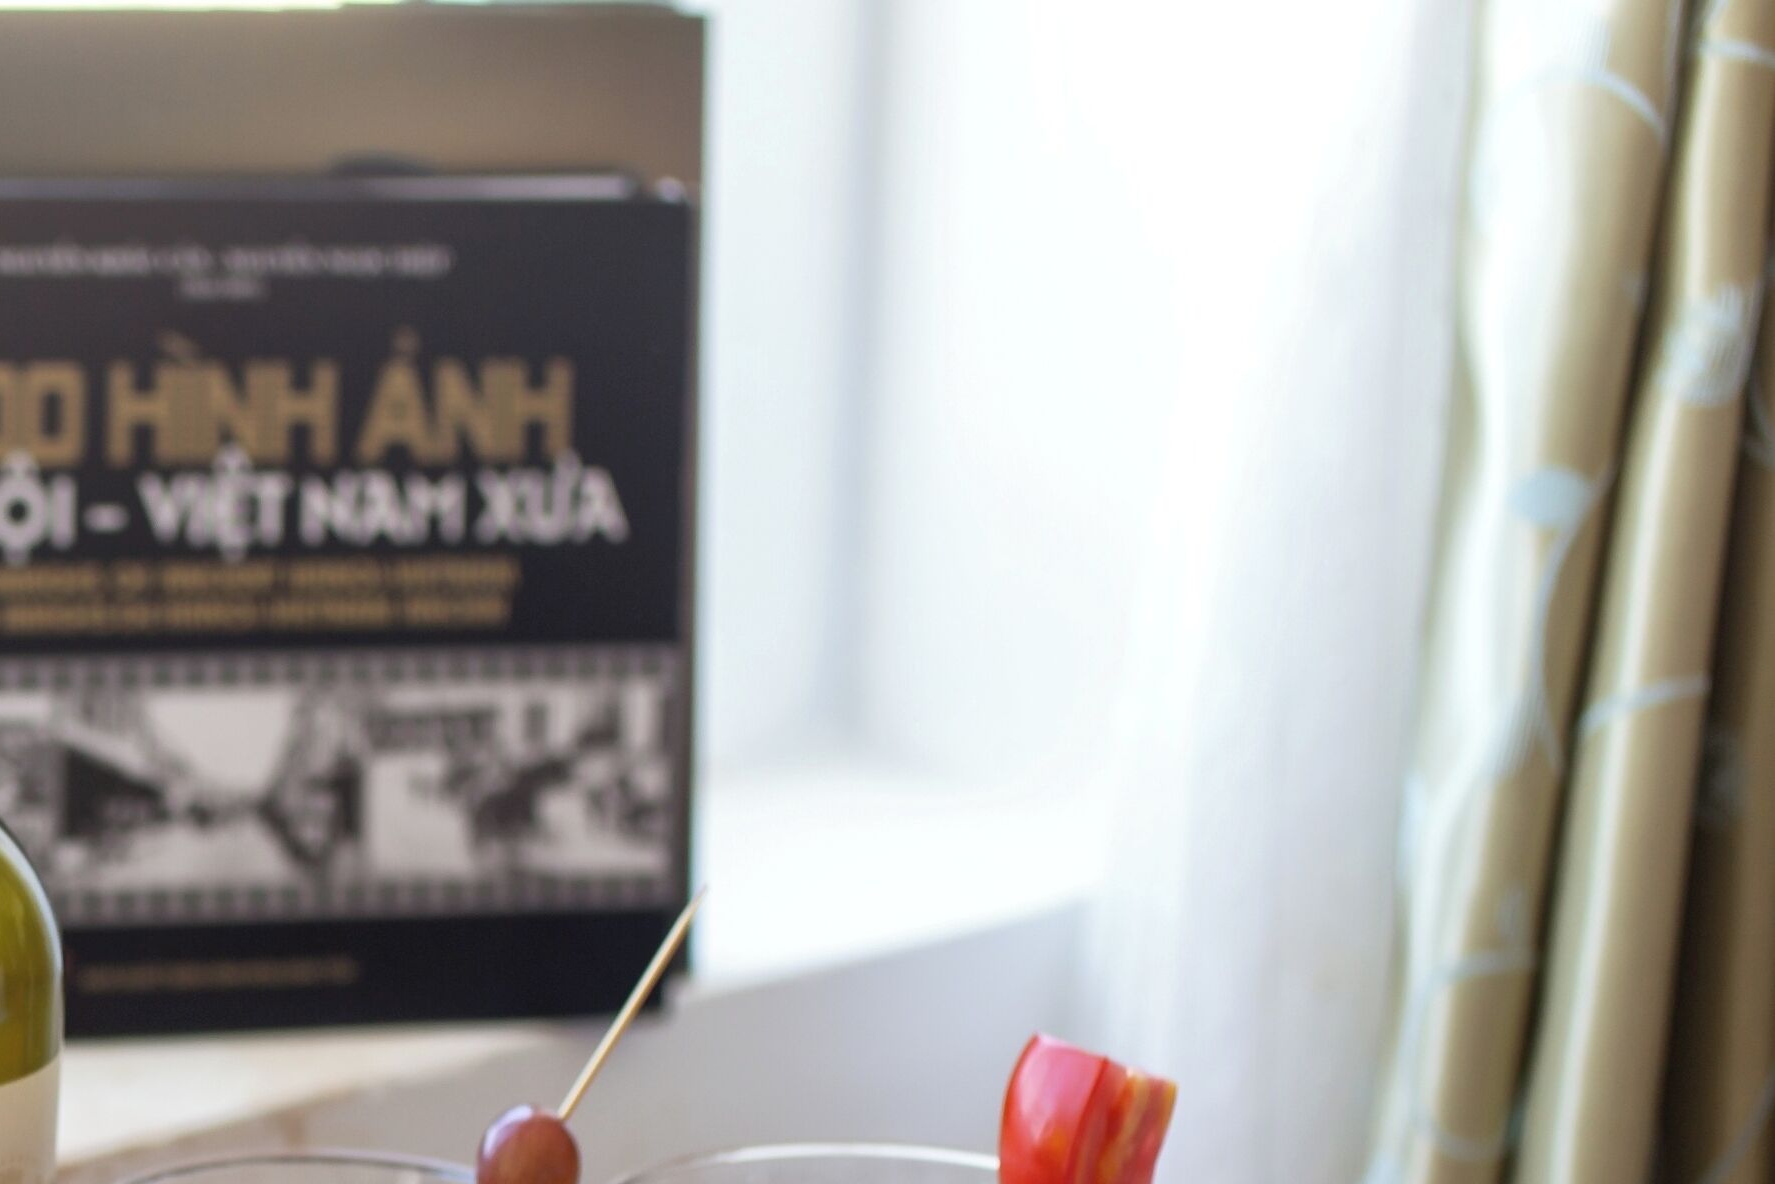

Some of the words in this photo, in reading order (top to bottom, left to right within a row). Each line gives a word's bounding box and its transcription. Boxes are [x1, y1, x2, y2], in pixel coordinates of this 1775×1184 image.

[104, 329, 341, 468] HÌNH
[356, 327, 574, 465] ẢNH
[136, 440, 292, 565] VIỆT
[299, 469, 467, 546] NAM
[474, 449, 631, 545] XƯA
